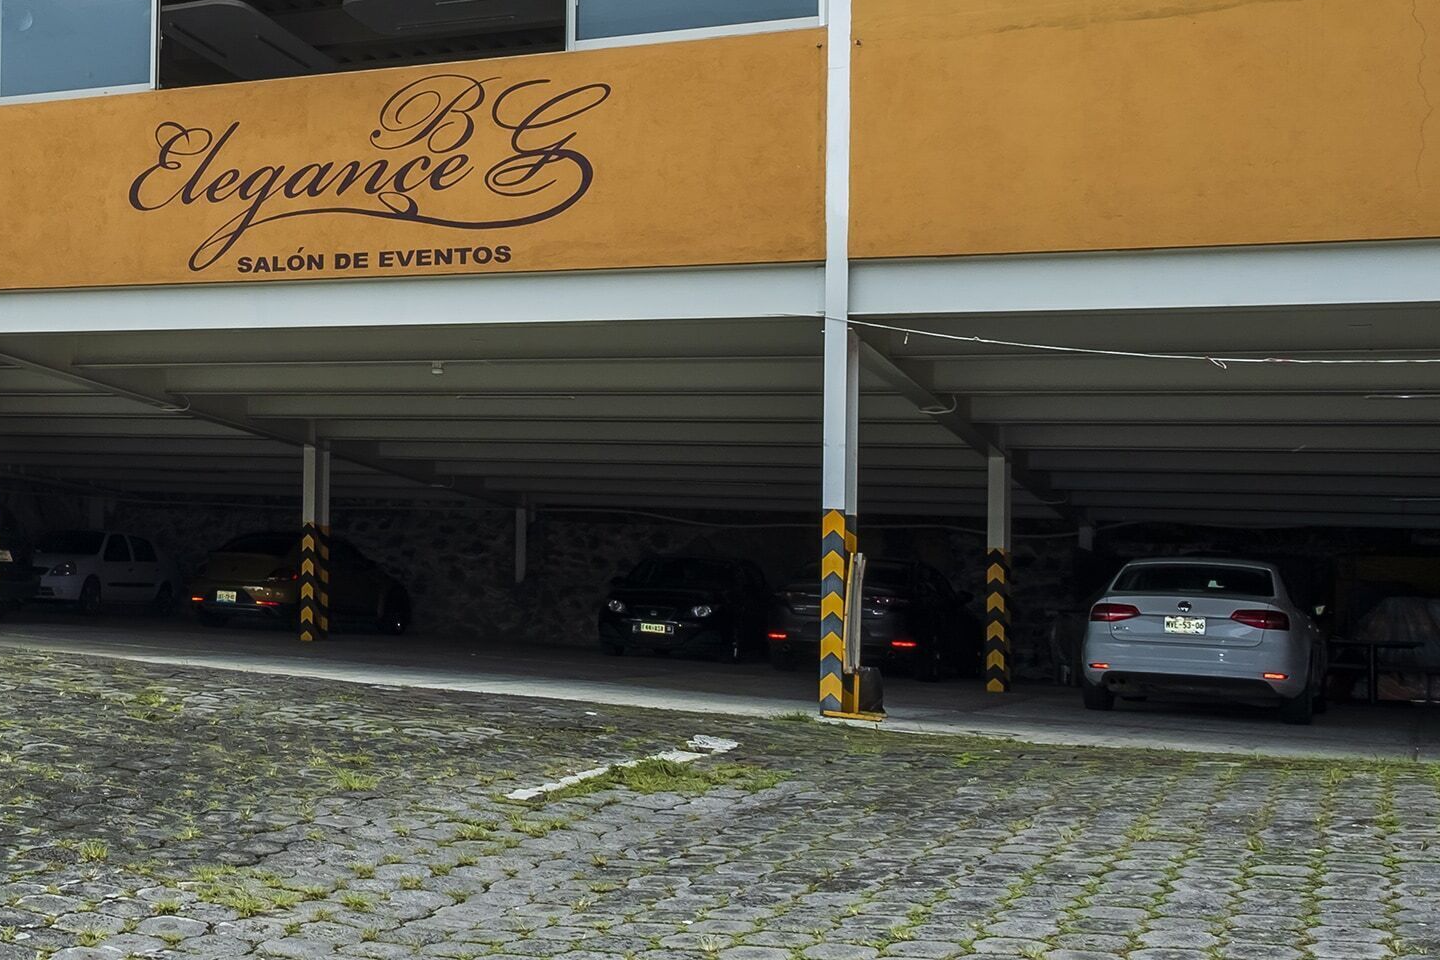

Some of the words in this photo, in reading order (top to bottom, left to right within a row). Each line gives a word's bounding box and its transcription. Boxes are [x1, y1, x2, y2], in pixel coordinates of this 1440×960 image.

[128, 121, 474, 272] Elegance
[237, 247, 325, 274] SALÓN
[334, 252, 369, 270] DE
[379, 245, 512, 268] EVENTOS
